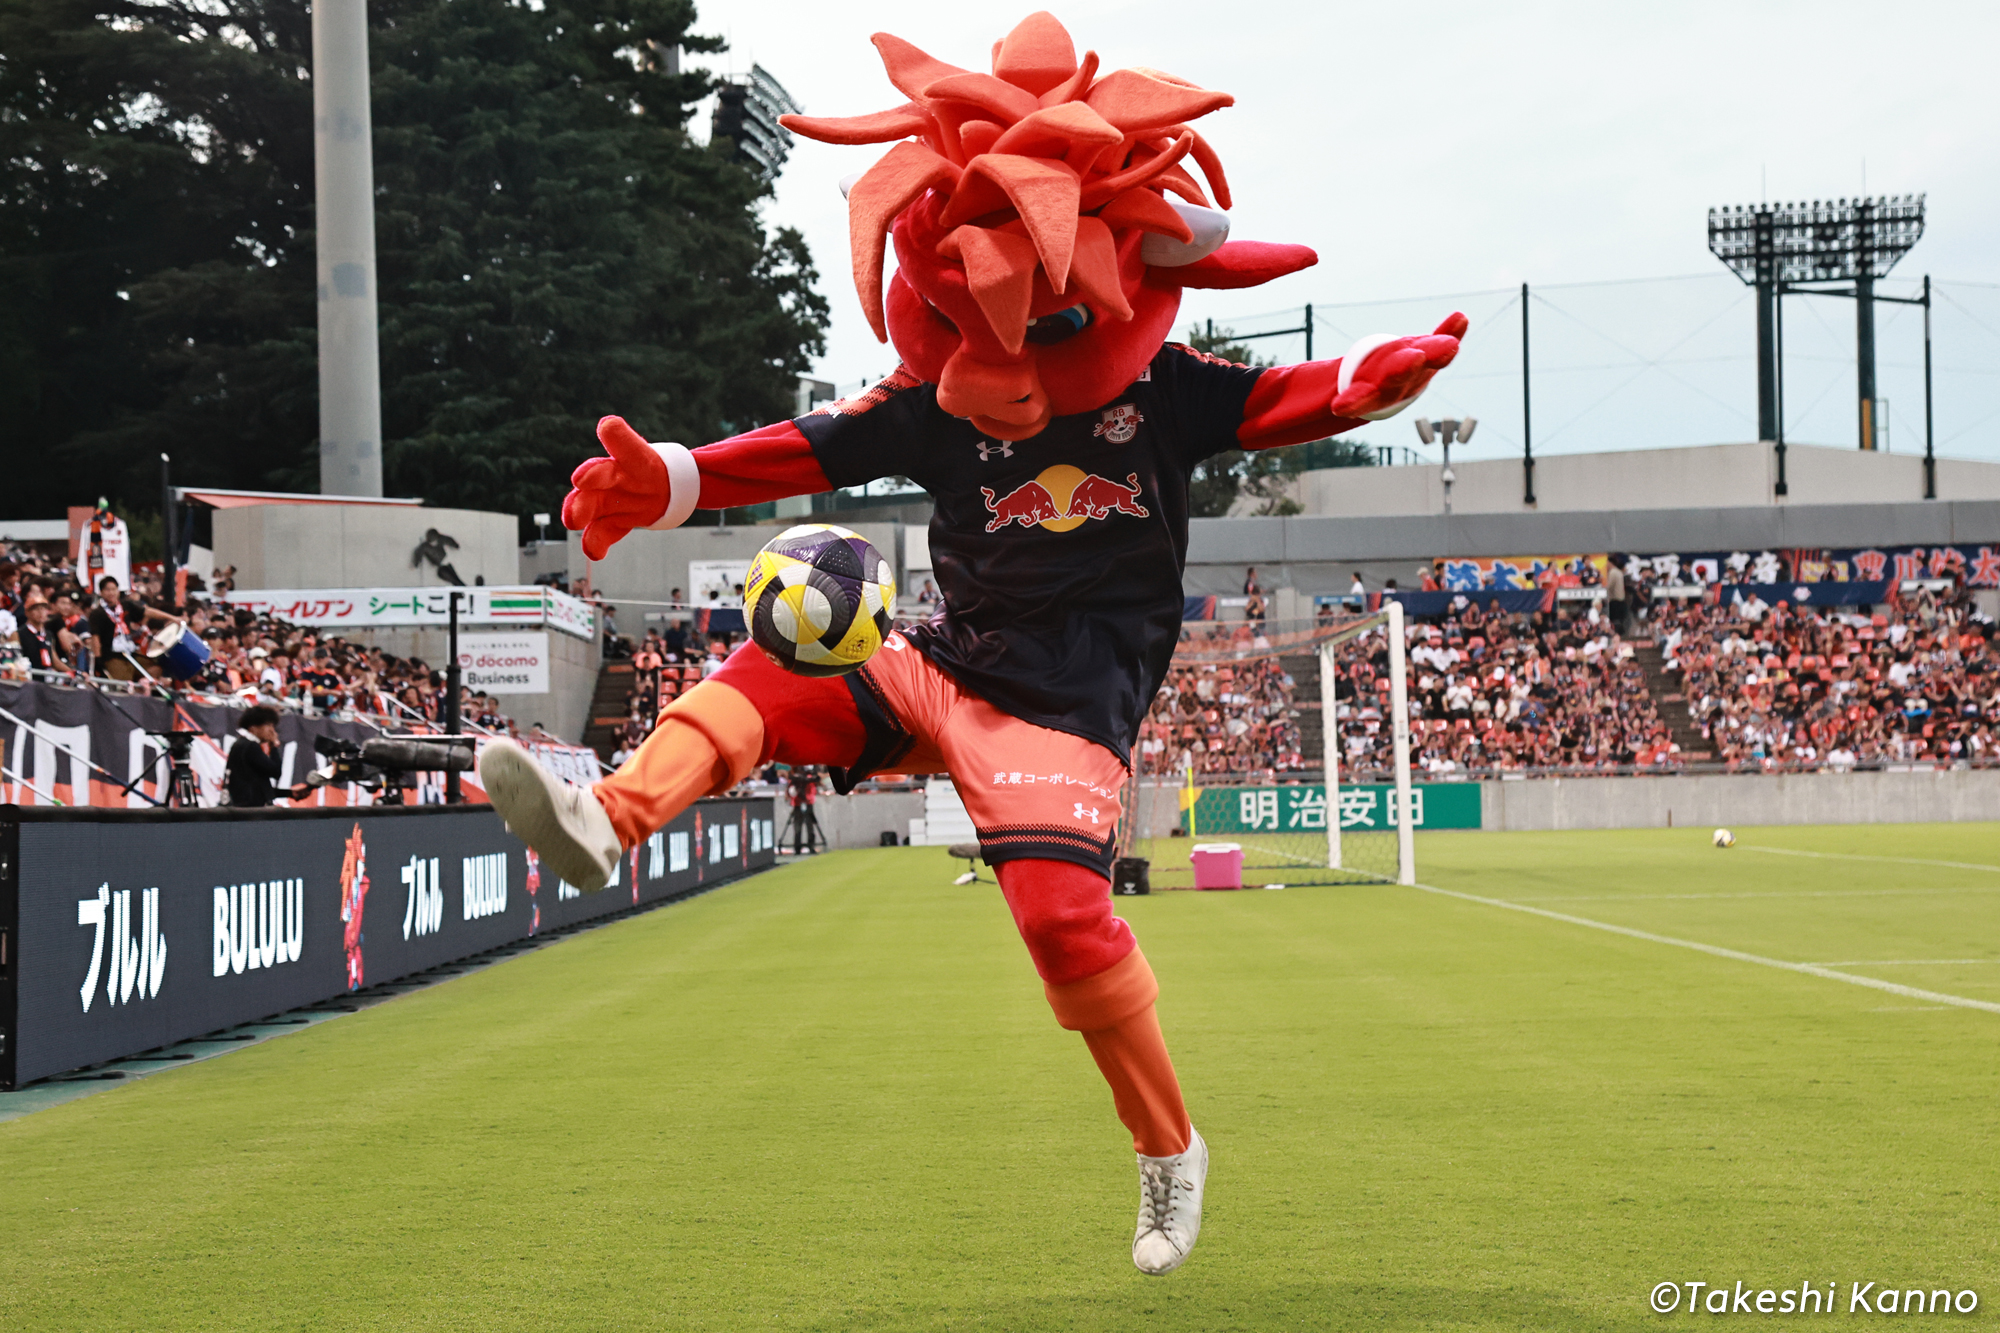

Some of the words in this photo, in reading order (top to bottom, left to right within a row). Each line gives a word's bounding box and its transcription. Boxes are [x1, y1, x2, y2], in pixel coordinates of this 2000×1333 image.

[1112, 408, 1126, 419] RB
[476, 654, 538, 668] docomo
[467, 671, 529, 685] Business
[992, 771, 1115, 800] 武蔵コーポレーション
[1239, 787, 1424, 830] 明治安田
[401, 854, 443, 941] ブルル
[462, 852, 508, 921] BULULU
[77, 882, 167, 1013] ブルル
[212, 877, 303, 977] BULULU
